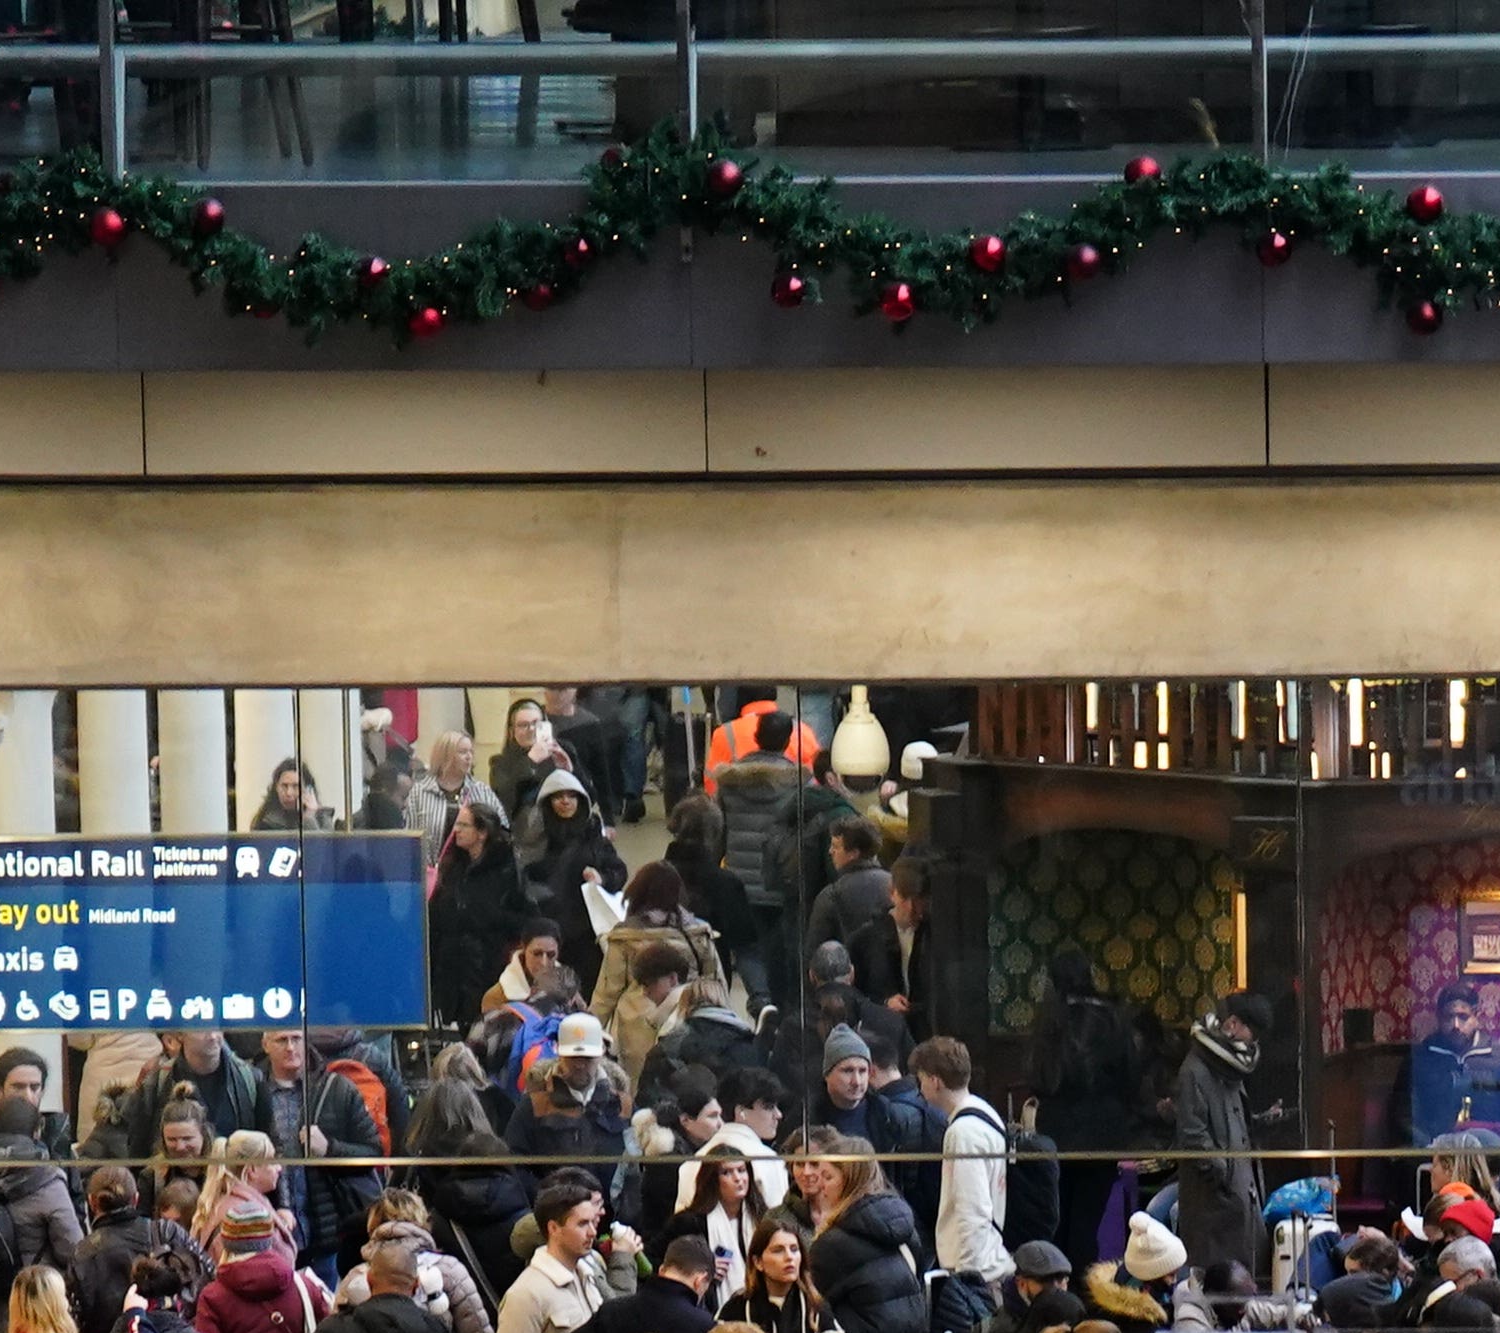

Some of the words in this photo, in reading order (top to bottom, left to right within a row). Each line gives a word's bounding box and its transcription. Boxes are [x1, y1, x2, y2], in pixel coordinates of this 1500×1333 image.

[92, 850, 144, 876] Rail
[153, 847, 200, 861] Tickets
[202, 846, 227, 861] and
[154, 859, 218, 878] platforms
[36, 900, 79, 924] out
[89, 909, 140, 923] Midland
[143, 908, 176, 923] Road
